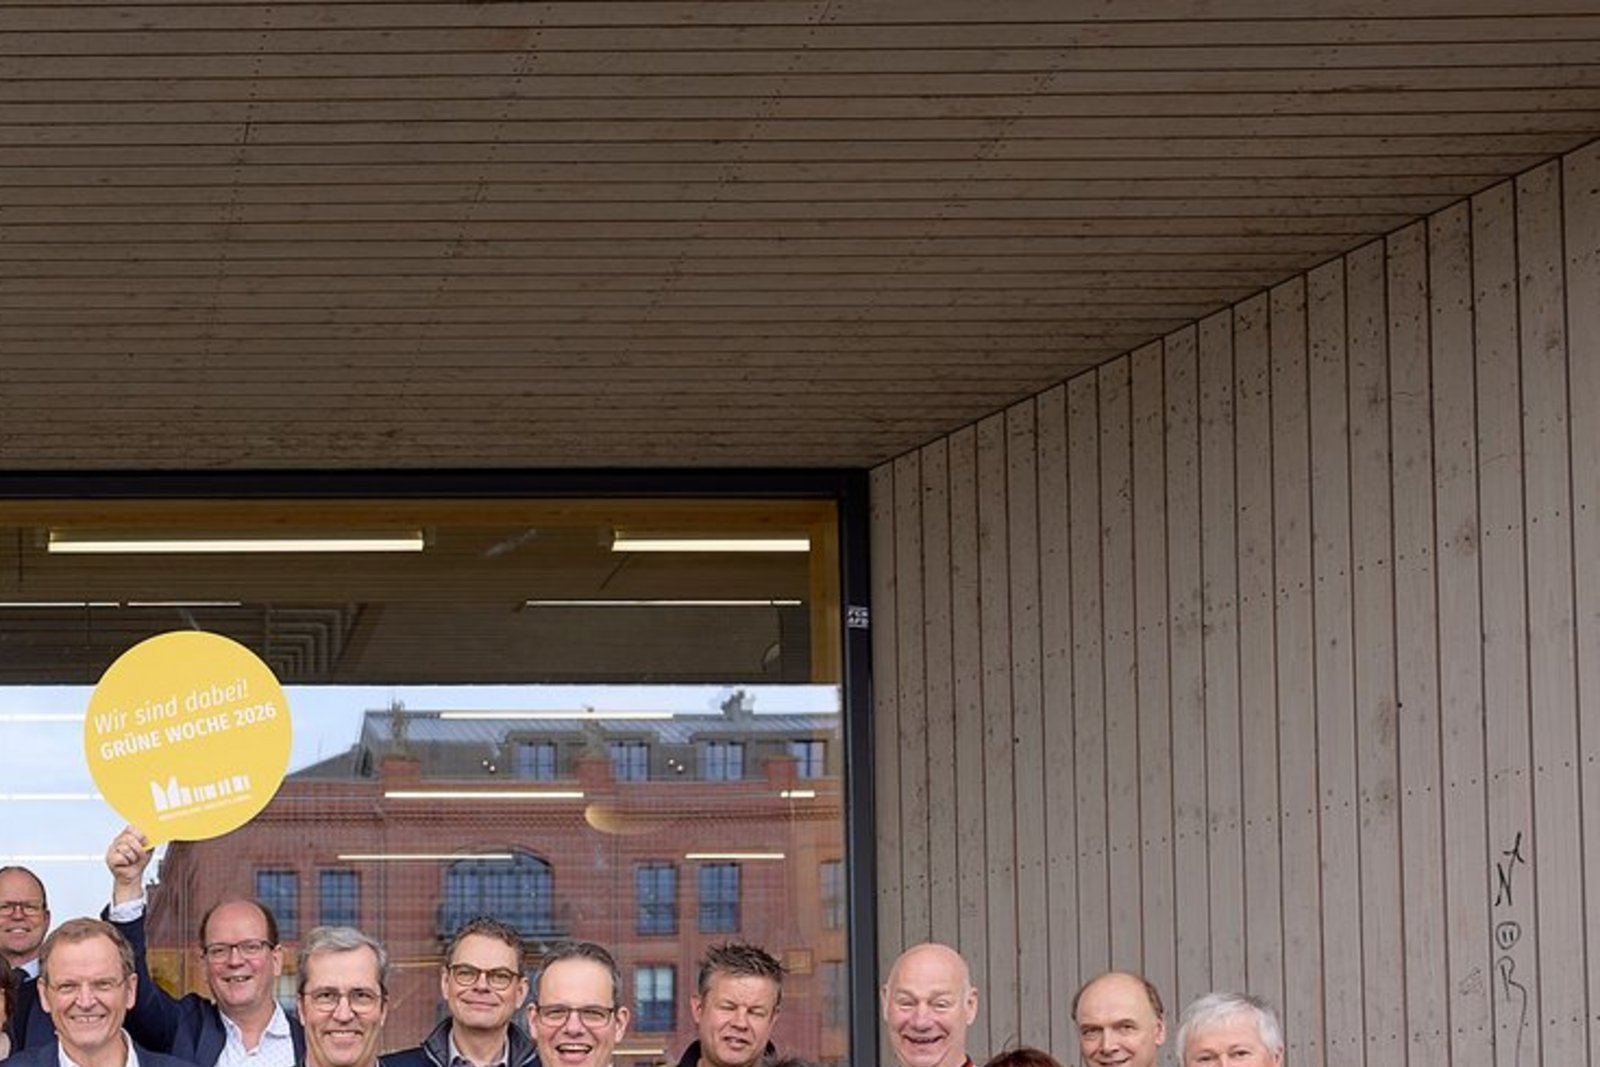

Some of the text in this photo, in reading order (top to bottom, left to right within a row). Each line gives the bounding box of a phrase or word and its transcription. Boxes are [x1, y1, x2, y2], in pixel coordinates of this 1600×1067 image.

[94, 679, 248, 735] Wir sind dabei!
[100, 702, 277, 761] GRÜNE WOCHE 2026
